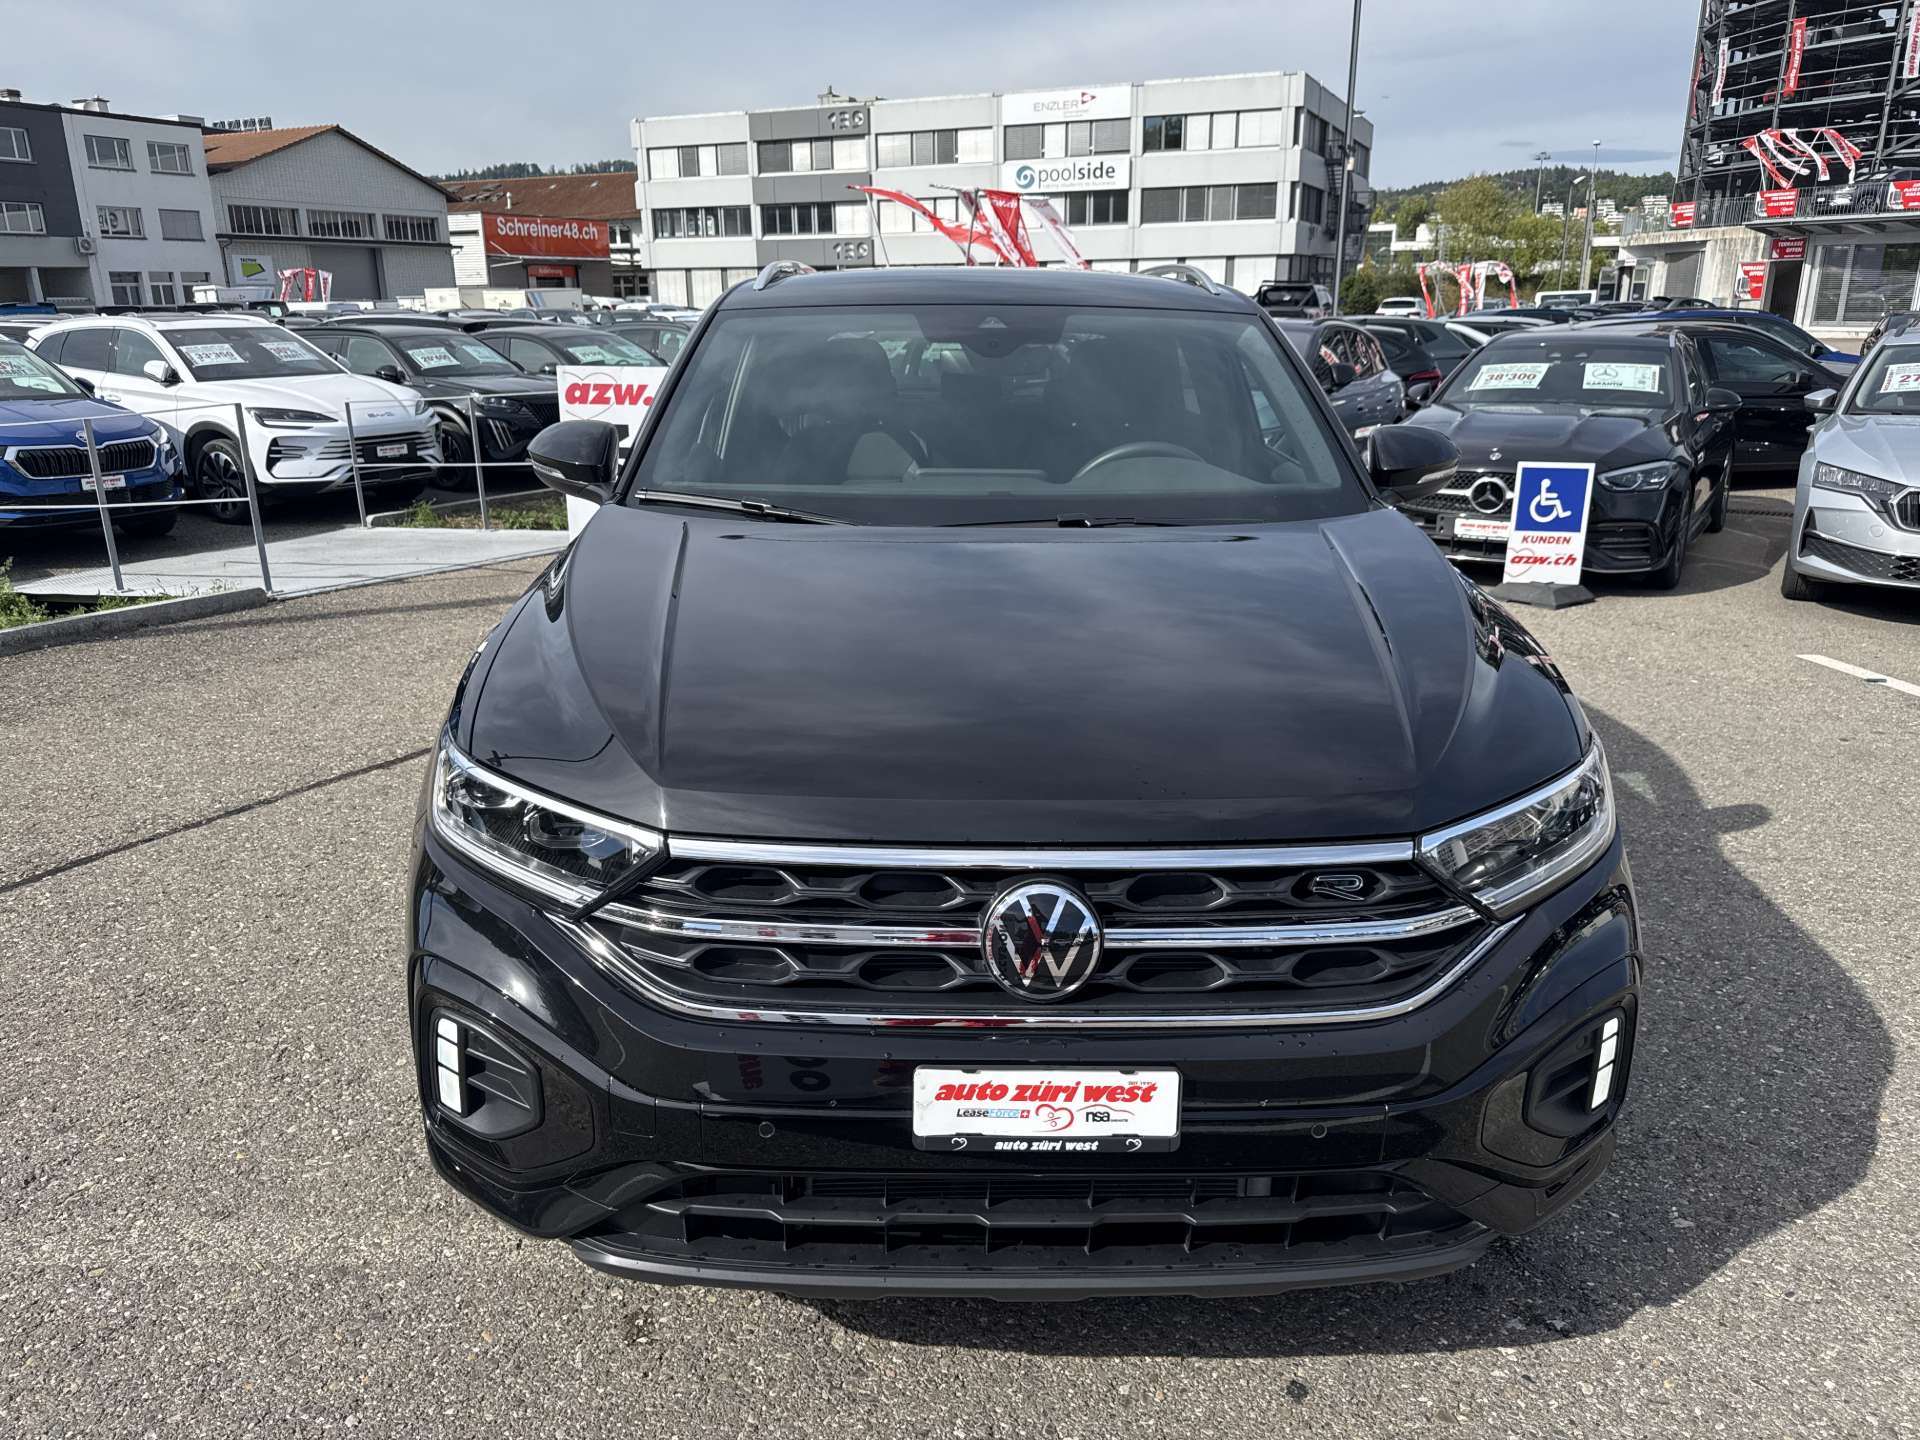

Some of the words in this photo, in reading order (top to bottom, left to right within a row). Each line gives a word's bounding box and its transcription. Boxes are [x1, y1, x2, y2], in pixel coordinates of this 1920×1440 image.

[1033, 99, 1080, 112] ENZLER
[1038, 161, 1116, 189] poolside
[496, 216, 598, 239] Schreiner48.ch
[1486, 372, 1538, 381] 38'300
[1521, 535, 1572, 544] KUNDEN
[1510, 553, 1577, 566] azw.ch
[934, 1080, 1010, 1101] auto
[1009, 1080, 1082, 1103] züri
[1083, 1083, 1159, 1103] west
[1085, 1111, 1111, 1123] nsa
[994, 1141, 1029, 1151] auto
[1030, 1140, 1063, 1151] züri
[1065, 1140, 1099, 1151] west
